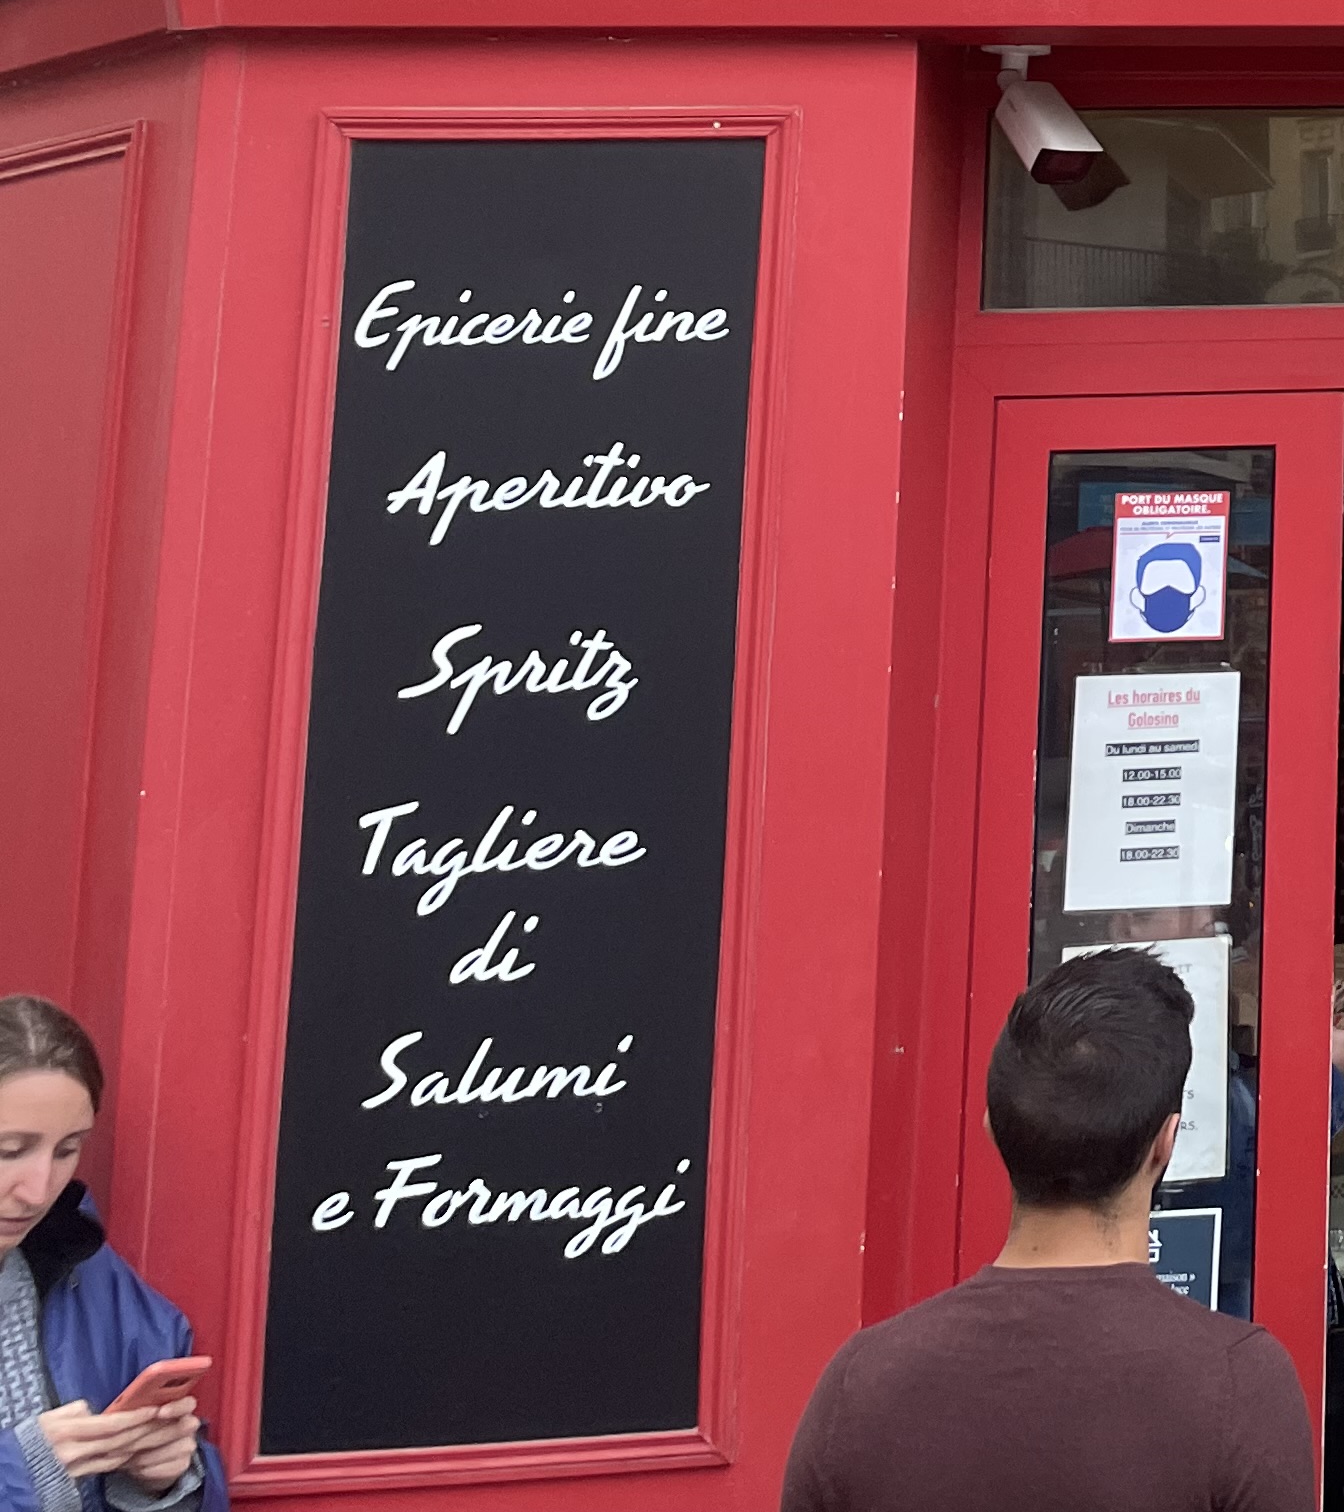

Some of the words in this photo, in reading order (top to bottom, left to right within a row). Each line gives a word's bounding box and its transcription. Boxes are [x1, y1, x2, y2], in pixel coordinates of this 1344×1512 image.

[354, 279, 595, 371] Epicerie
[592, 284, 731, 381] fine
[386, 441, 712, 547] Aperitivo
[1121, 494, 1152, 506] PORT
[1154, 494, 1171, 505] DU
[1173, 493, 1224, 505] MASQUE
[1132, 504, 1212, 516] OBLIGATOIRE.
[397, 623, 640, 736] Spritz
[1107, 690, 1129, 706] Les
[1132, 687, 1182, 705] horaires
[1185, 686, 1201, 703] du
[1127, 710, 1180, 728] Golosino
[1106, 744, 1120, 756] Du
[1122, 743, 1147, 755] lundi
[1148, 744, 1162, 754] au
[1123, 767, 1182, 781] 12.00-15.00
[1122, 794, 1180, 807] 18.00-22.30
[1126, 820, 1176, 833] Dimanche
[358, 801, 647, 917] Tagliere
[1120, 846, 1179, 861] 18.00-22.30
[449, 910, 540, 985] di
[360, 1031, 635, 1111] Salumi
[311, 1191, 355, 1232] e
[374, 1153, 691, 1260] Formaggi
